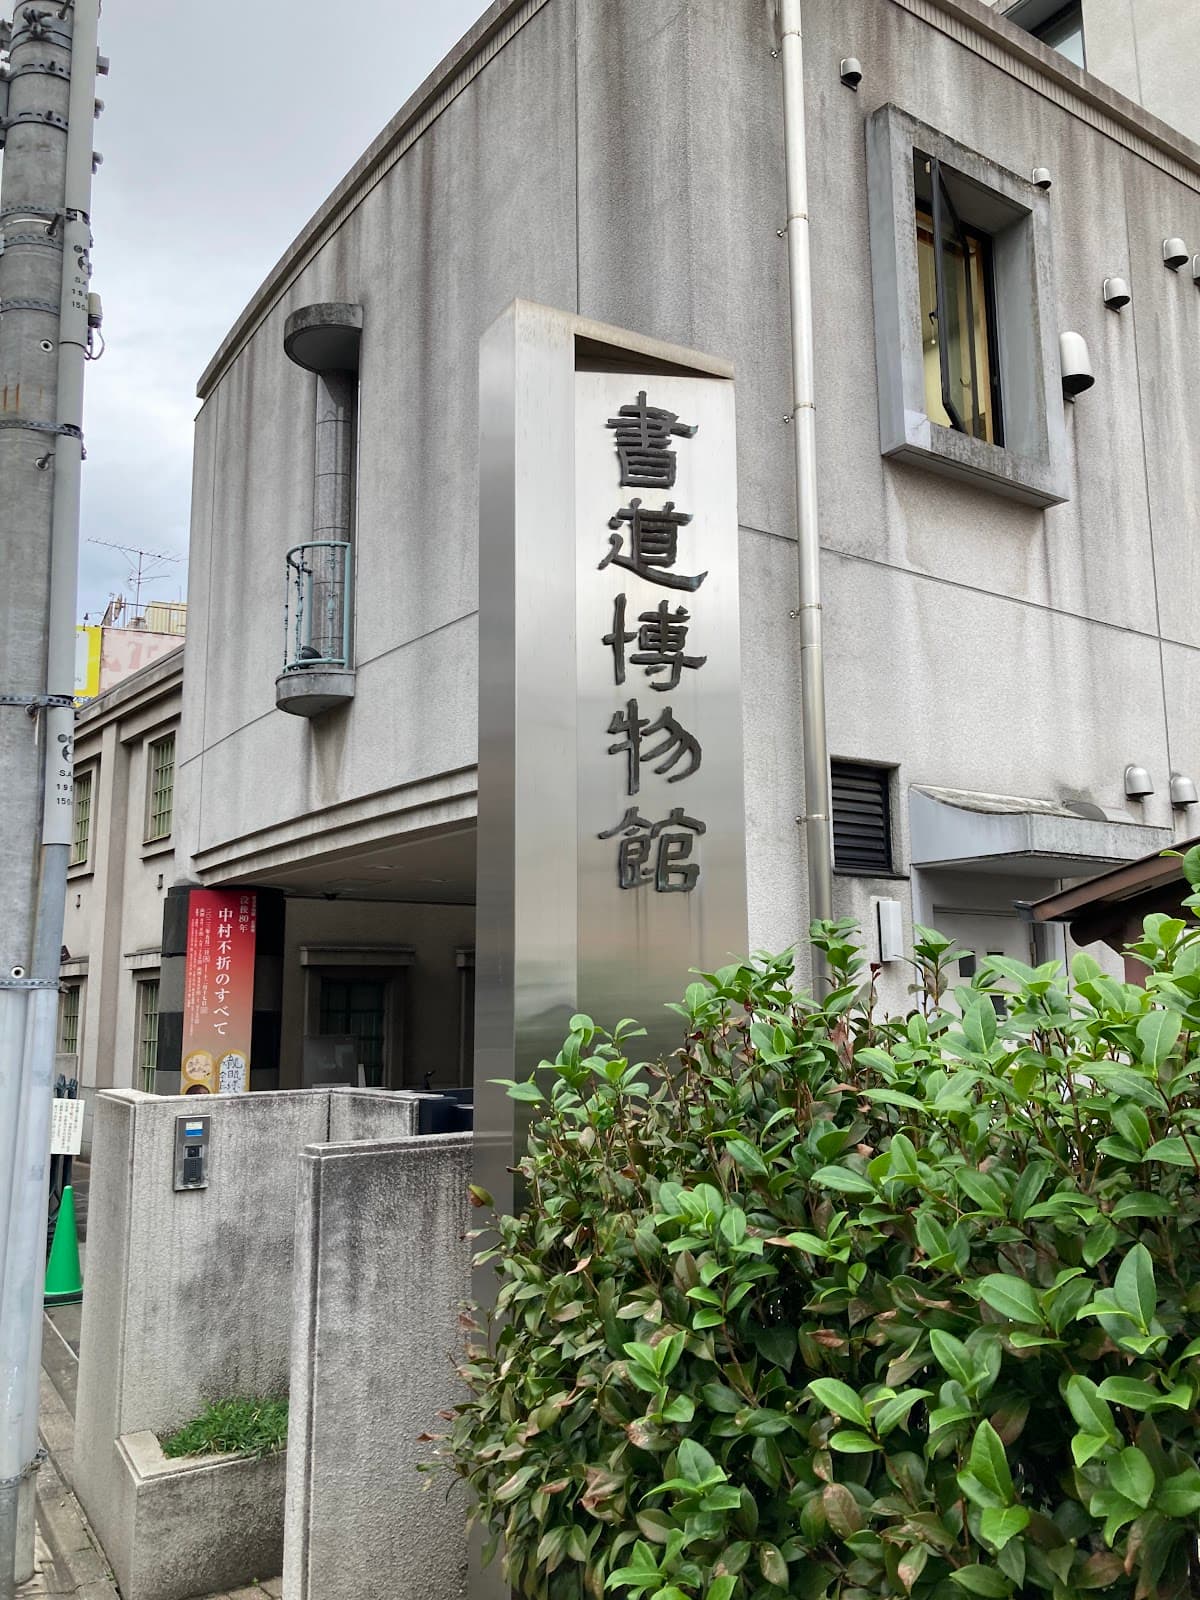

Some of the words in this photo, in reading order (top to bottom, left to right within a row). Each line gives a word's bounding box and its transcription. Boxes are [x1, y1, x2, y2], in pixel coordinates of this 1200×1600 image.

[598, 390, 708, 894] 書道博物館
[213, 907, 233, 1035] 中村不折のすべて
